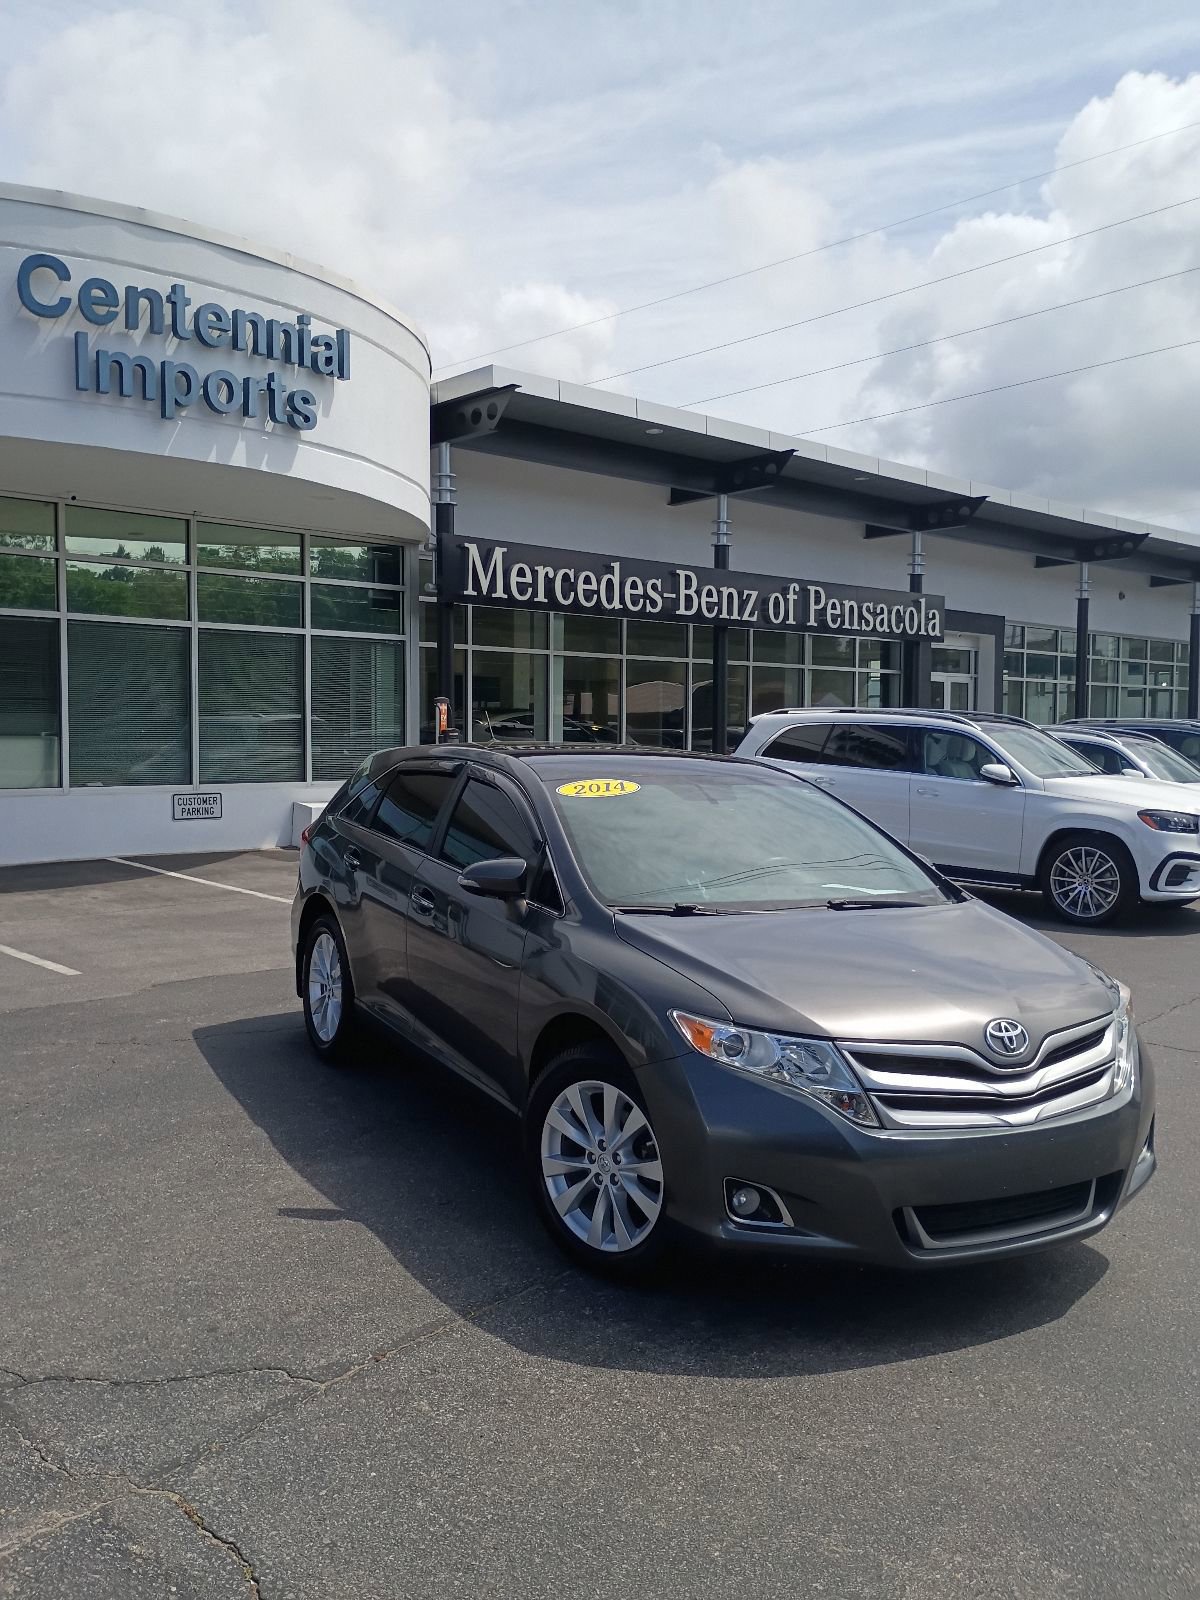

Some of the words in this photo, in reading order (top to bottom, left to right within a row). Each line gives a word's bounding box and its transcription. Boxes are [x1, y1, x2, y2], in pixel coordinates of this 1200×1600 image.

[17, 254, 351, 381] Centennial
[75, 331, 318, 431] Imports
[463, 542, 759, 622] Mercedes-Benz
[768, 583, 800, 625] of
[807, 585, 941, 637] Pensacola
[177, 796, 218, 806] CUSTOMER
[181, 806, 215, 816] PARKING
[573, 781, 627, 795] 2014
